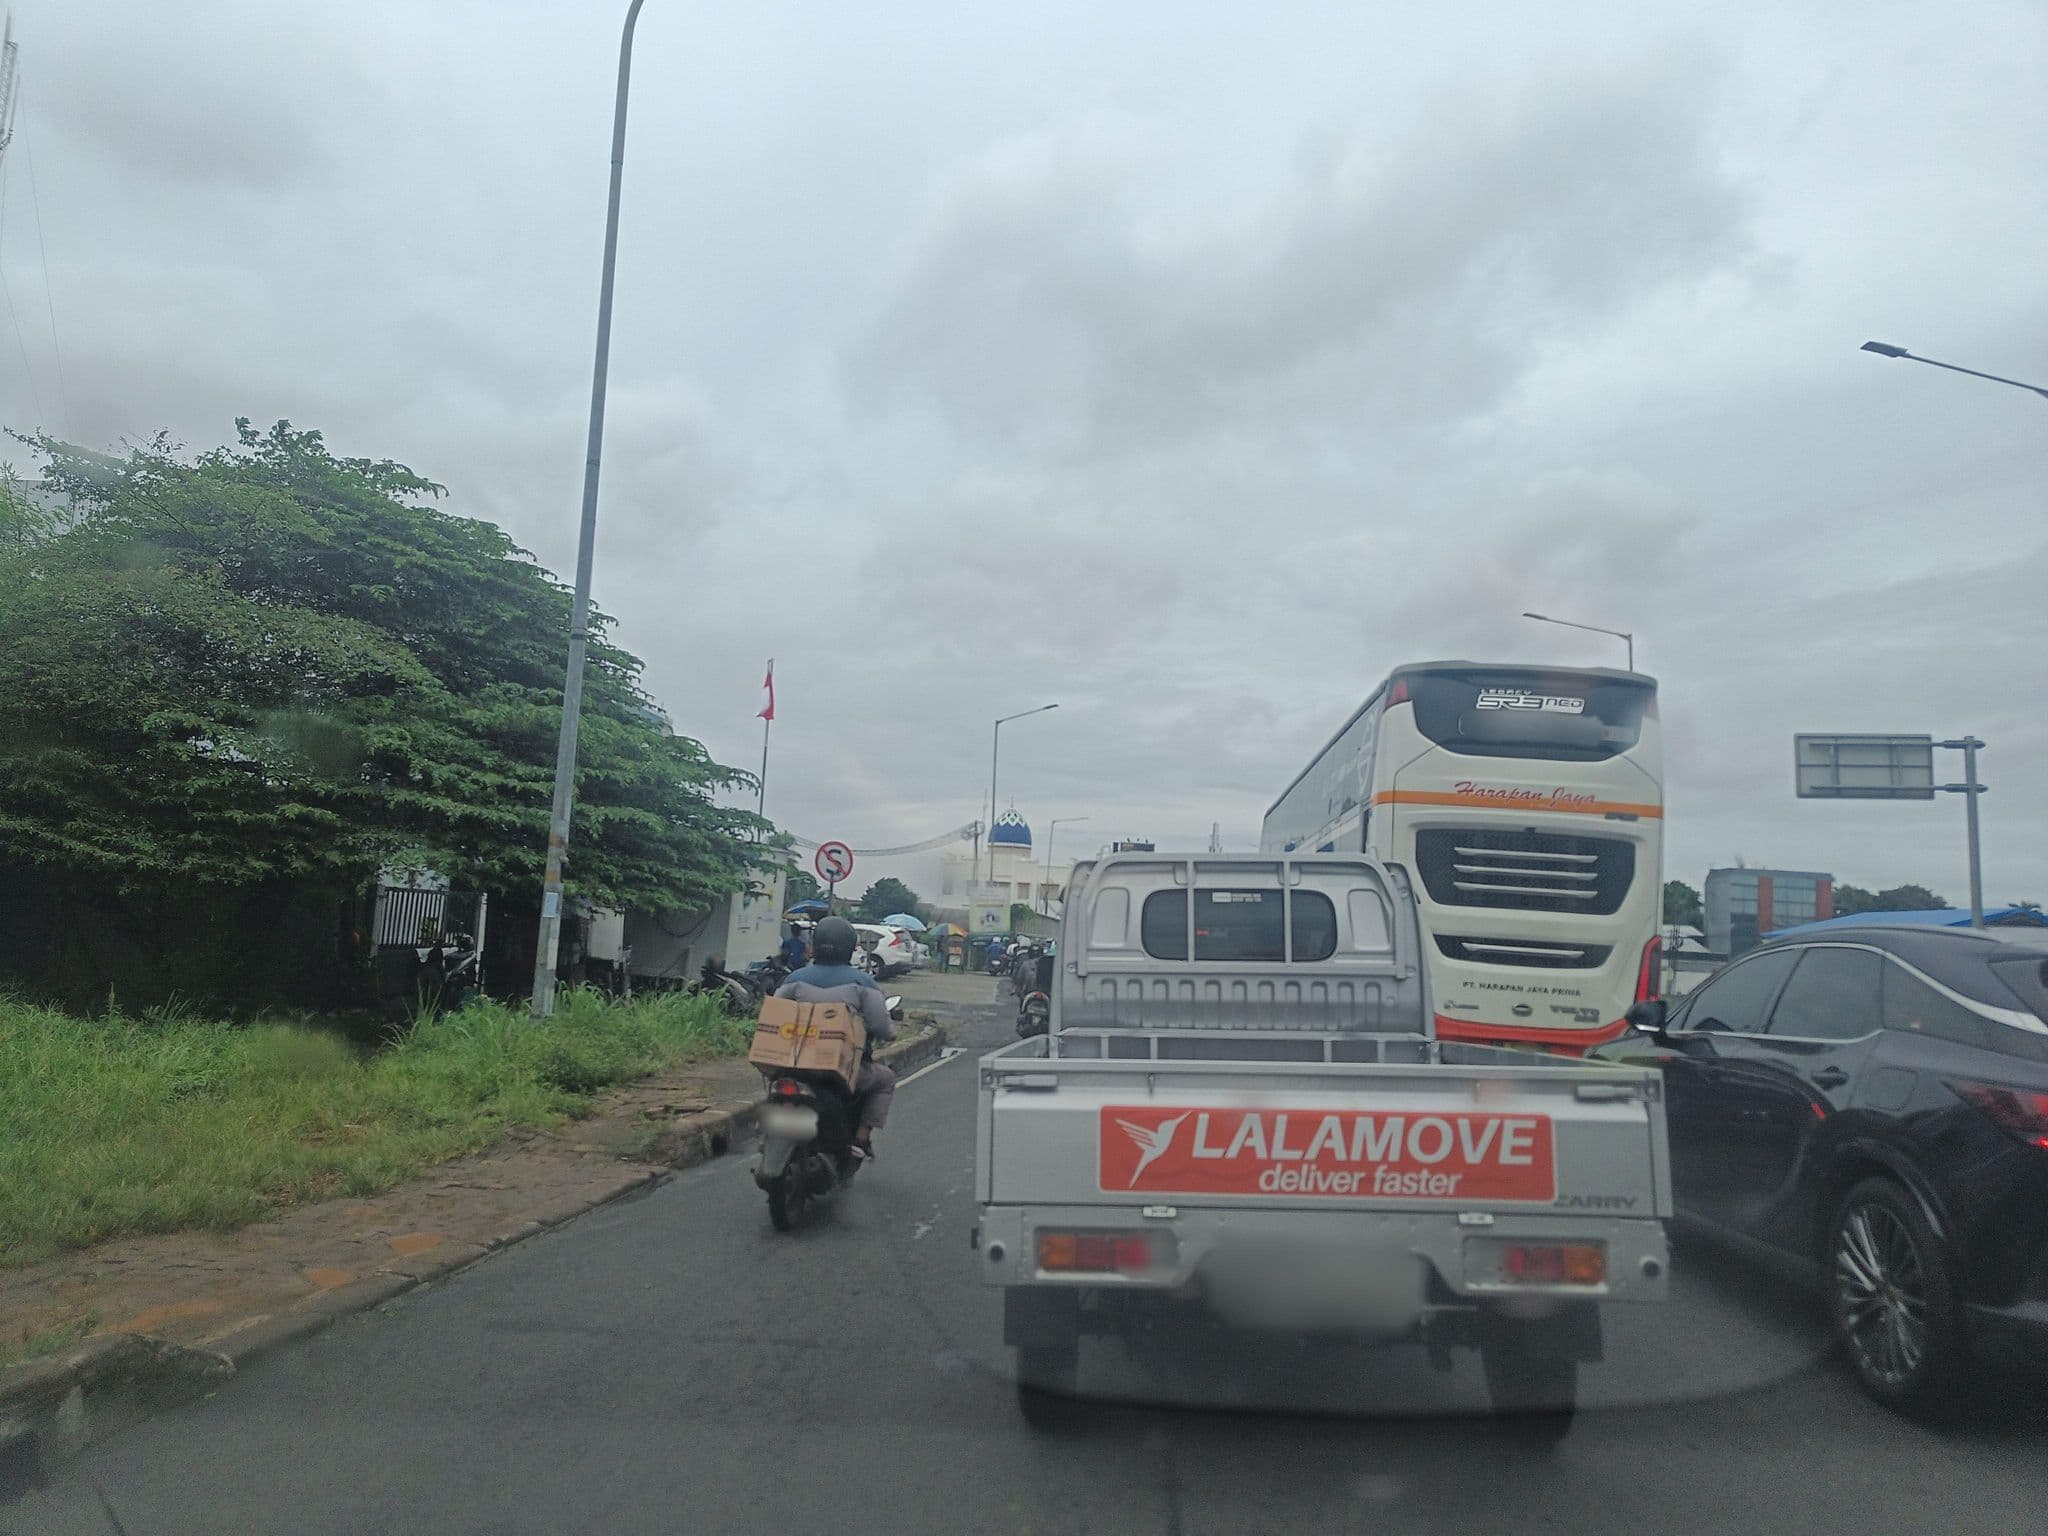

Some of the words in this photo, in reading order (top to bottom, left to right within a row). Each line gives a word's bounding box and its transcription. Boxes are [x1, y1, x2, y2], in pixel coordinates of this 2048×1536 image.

[1454, 781, 1544, 801] Harapan
[1550, 787, 1596, 807] Jaya
[1479, 983, 1524, 993] HARAPAN
[1527, 986, 1549, 994] JAYA
[1191, 1113, 1537, 1165] LALAMOVE
[1258, 1164, 1365, 1194] deliver
[1373, 1166, 1464, 1196] faster
